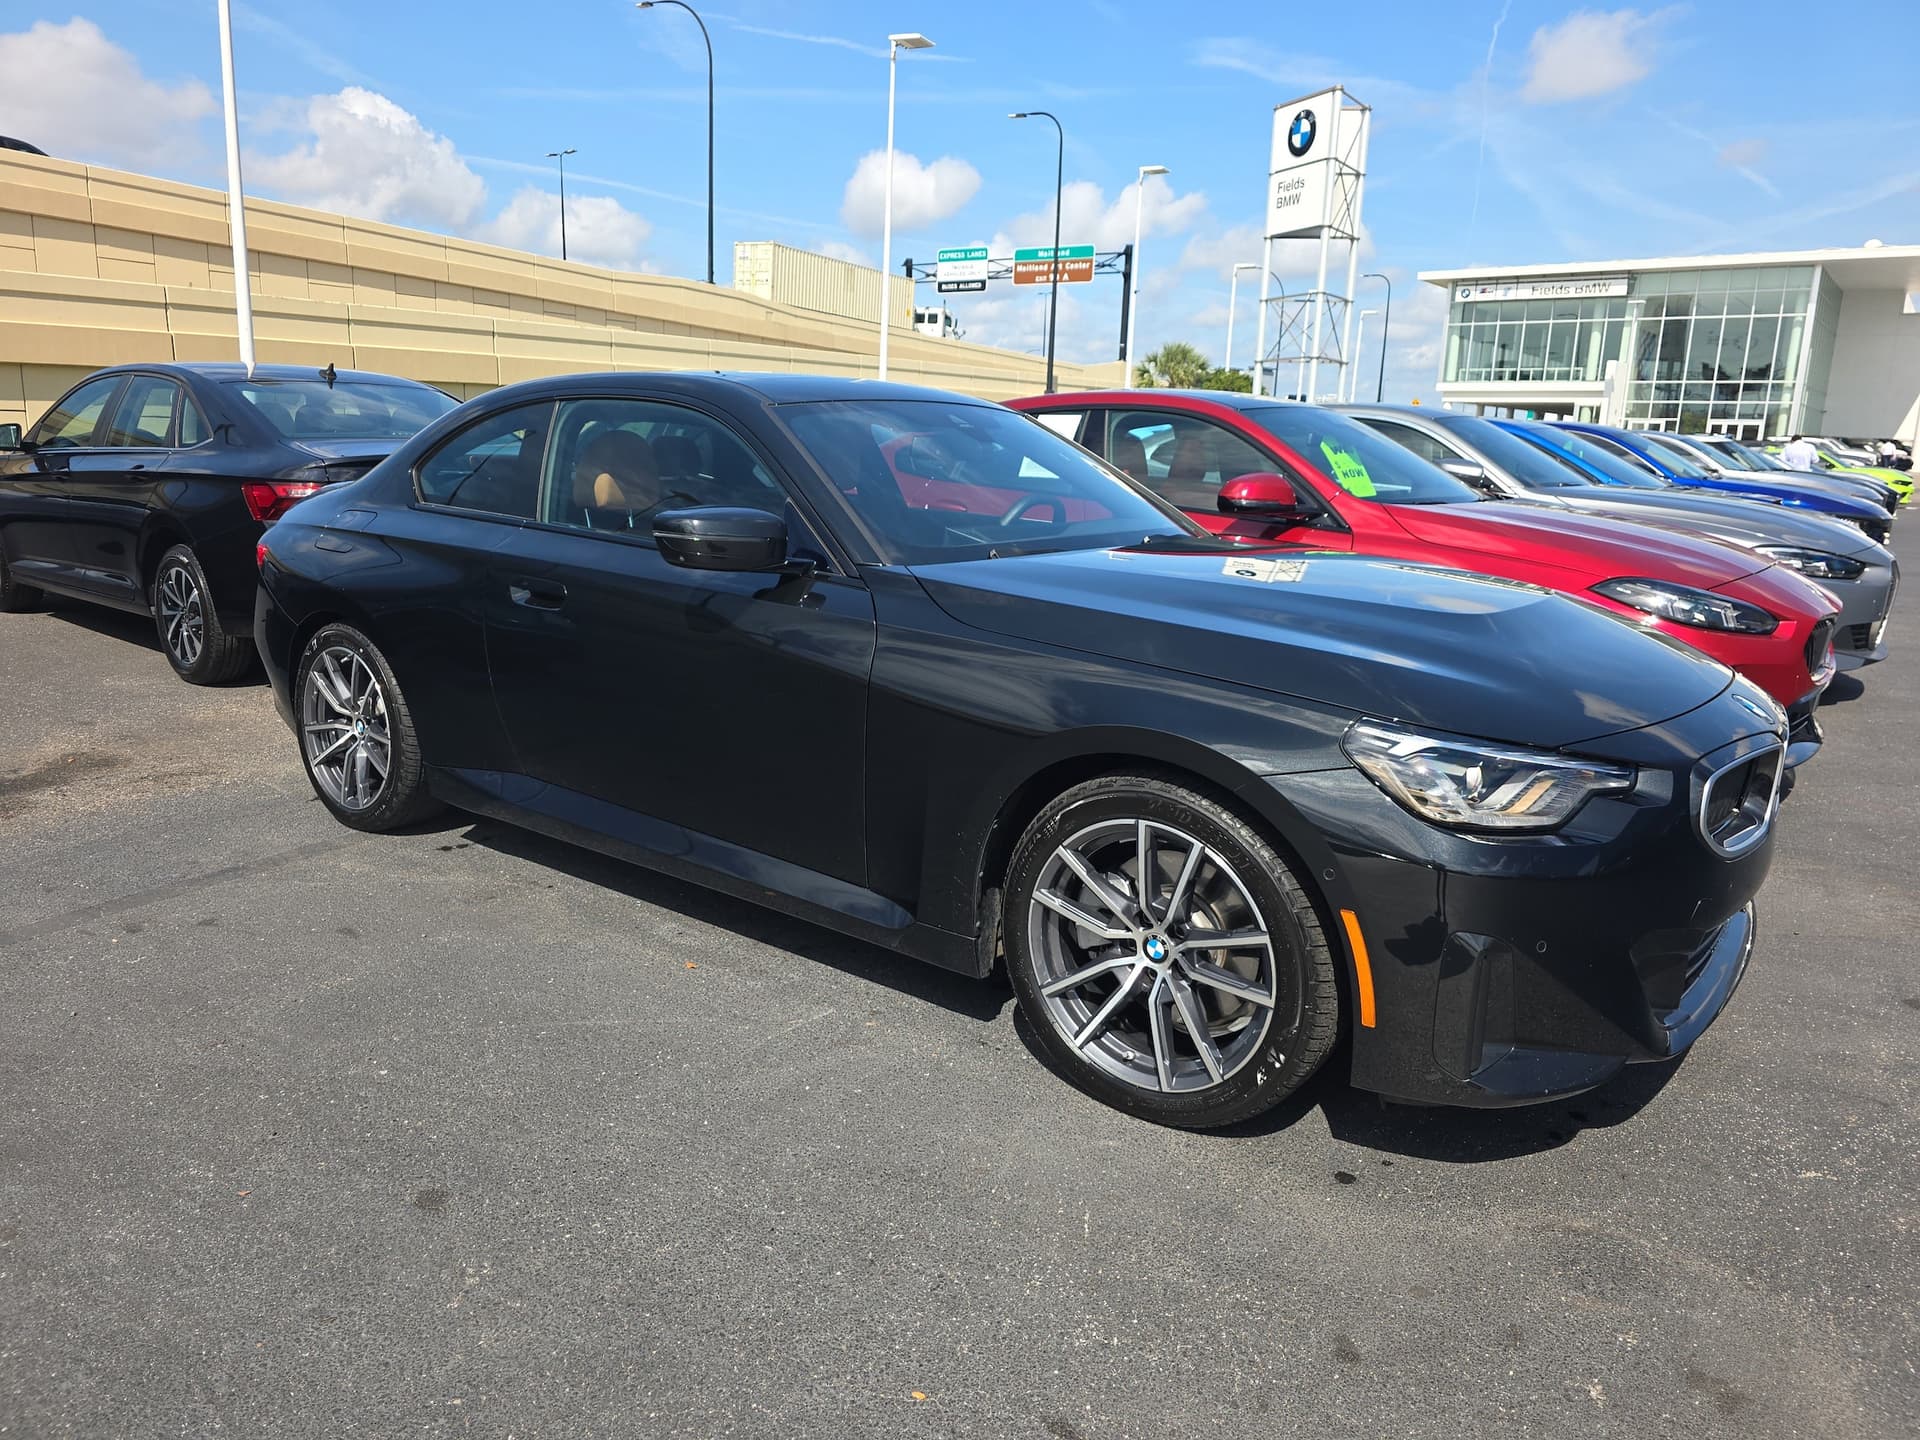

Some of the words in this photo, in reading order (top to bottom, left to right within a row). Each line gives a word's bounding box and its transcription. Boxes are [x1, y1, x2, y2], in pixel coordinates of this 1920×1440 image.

[1277, 176, 1305, 194] Fields
[1276, 192, 1301, 209] BMW
[940, 251, 965, 259] EXPRESS
[967, 250, 986, 258] LANES
[1038, 249, 1070, 257] Maitand
[1016, 263, 1048, 272] Maitland
[1062, 272, 1069, 280] A
[1531, 284, 1570, 295] Fields
[1574, 282, 1612, 294] BMW
[1342, 469, 1364, 479] NOW
